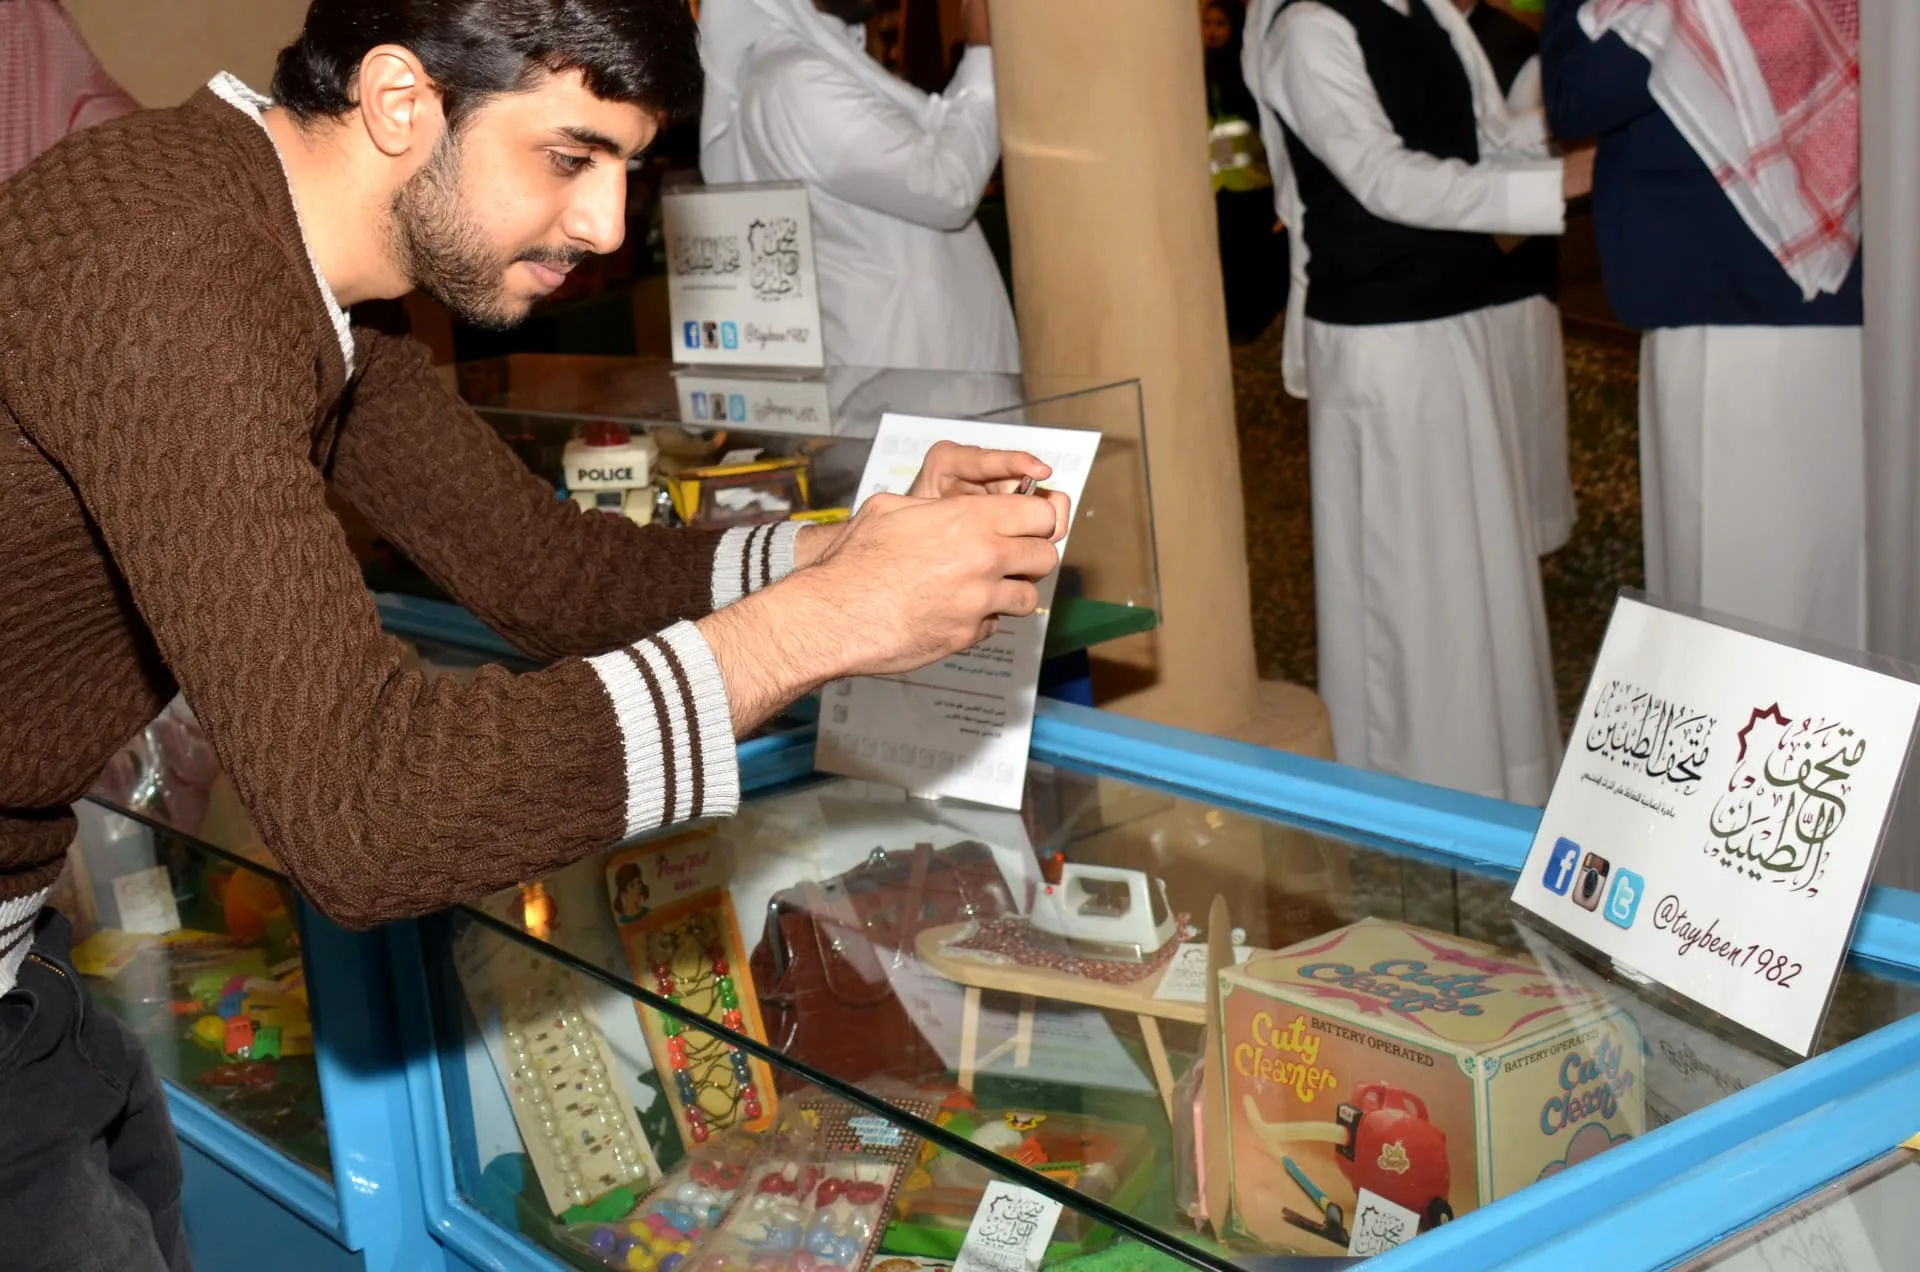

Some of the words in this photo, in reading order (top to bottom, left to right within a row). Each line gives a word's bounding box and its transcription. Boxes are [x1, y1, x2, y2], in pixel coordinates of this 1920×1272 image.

[578, 467, 633, 481] POLICE
[1653, 894, 1802, 989] @taybeen1982
[1251, 1011, 1321, 1065] Cuty
[1311, 1016, 1366, 1046] BATTERY
[1367, 1035, 1434, 1067] OPERATED
[1504, 1047, 1549, 1073] BATTERY
[1550, 1029, 1600, 1055] OPERATED
[1559, 1033, 1624, 1090] Cuty
[1234, 1042, 1338, 1103] Cleaner
[1540, 1069, 1635, 1136] Cleaner
